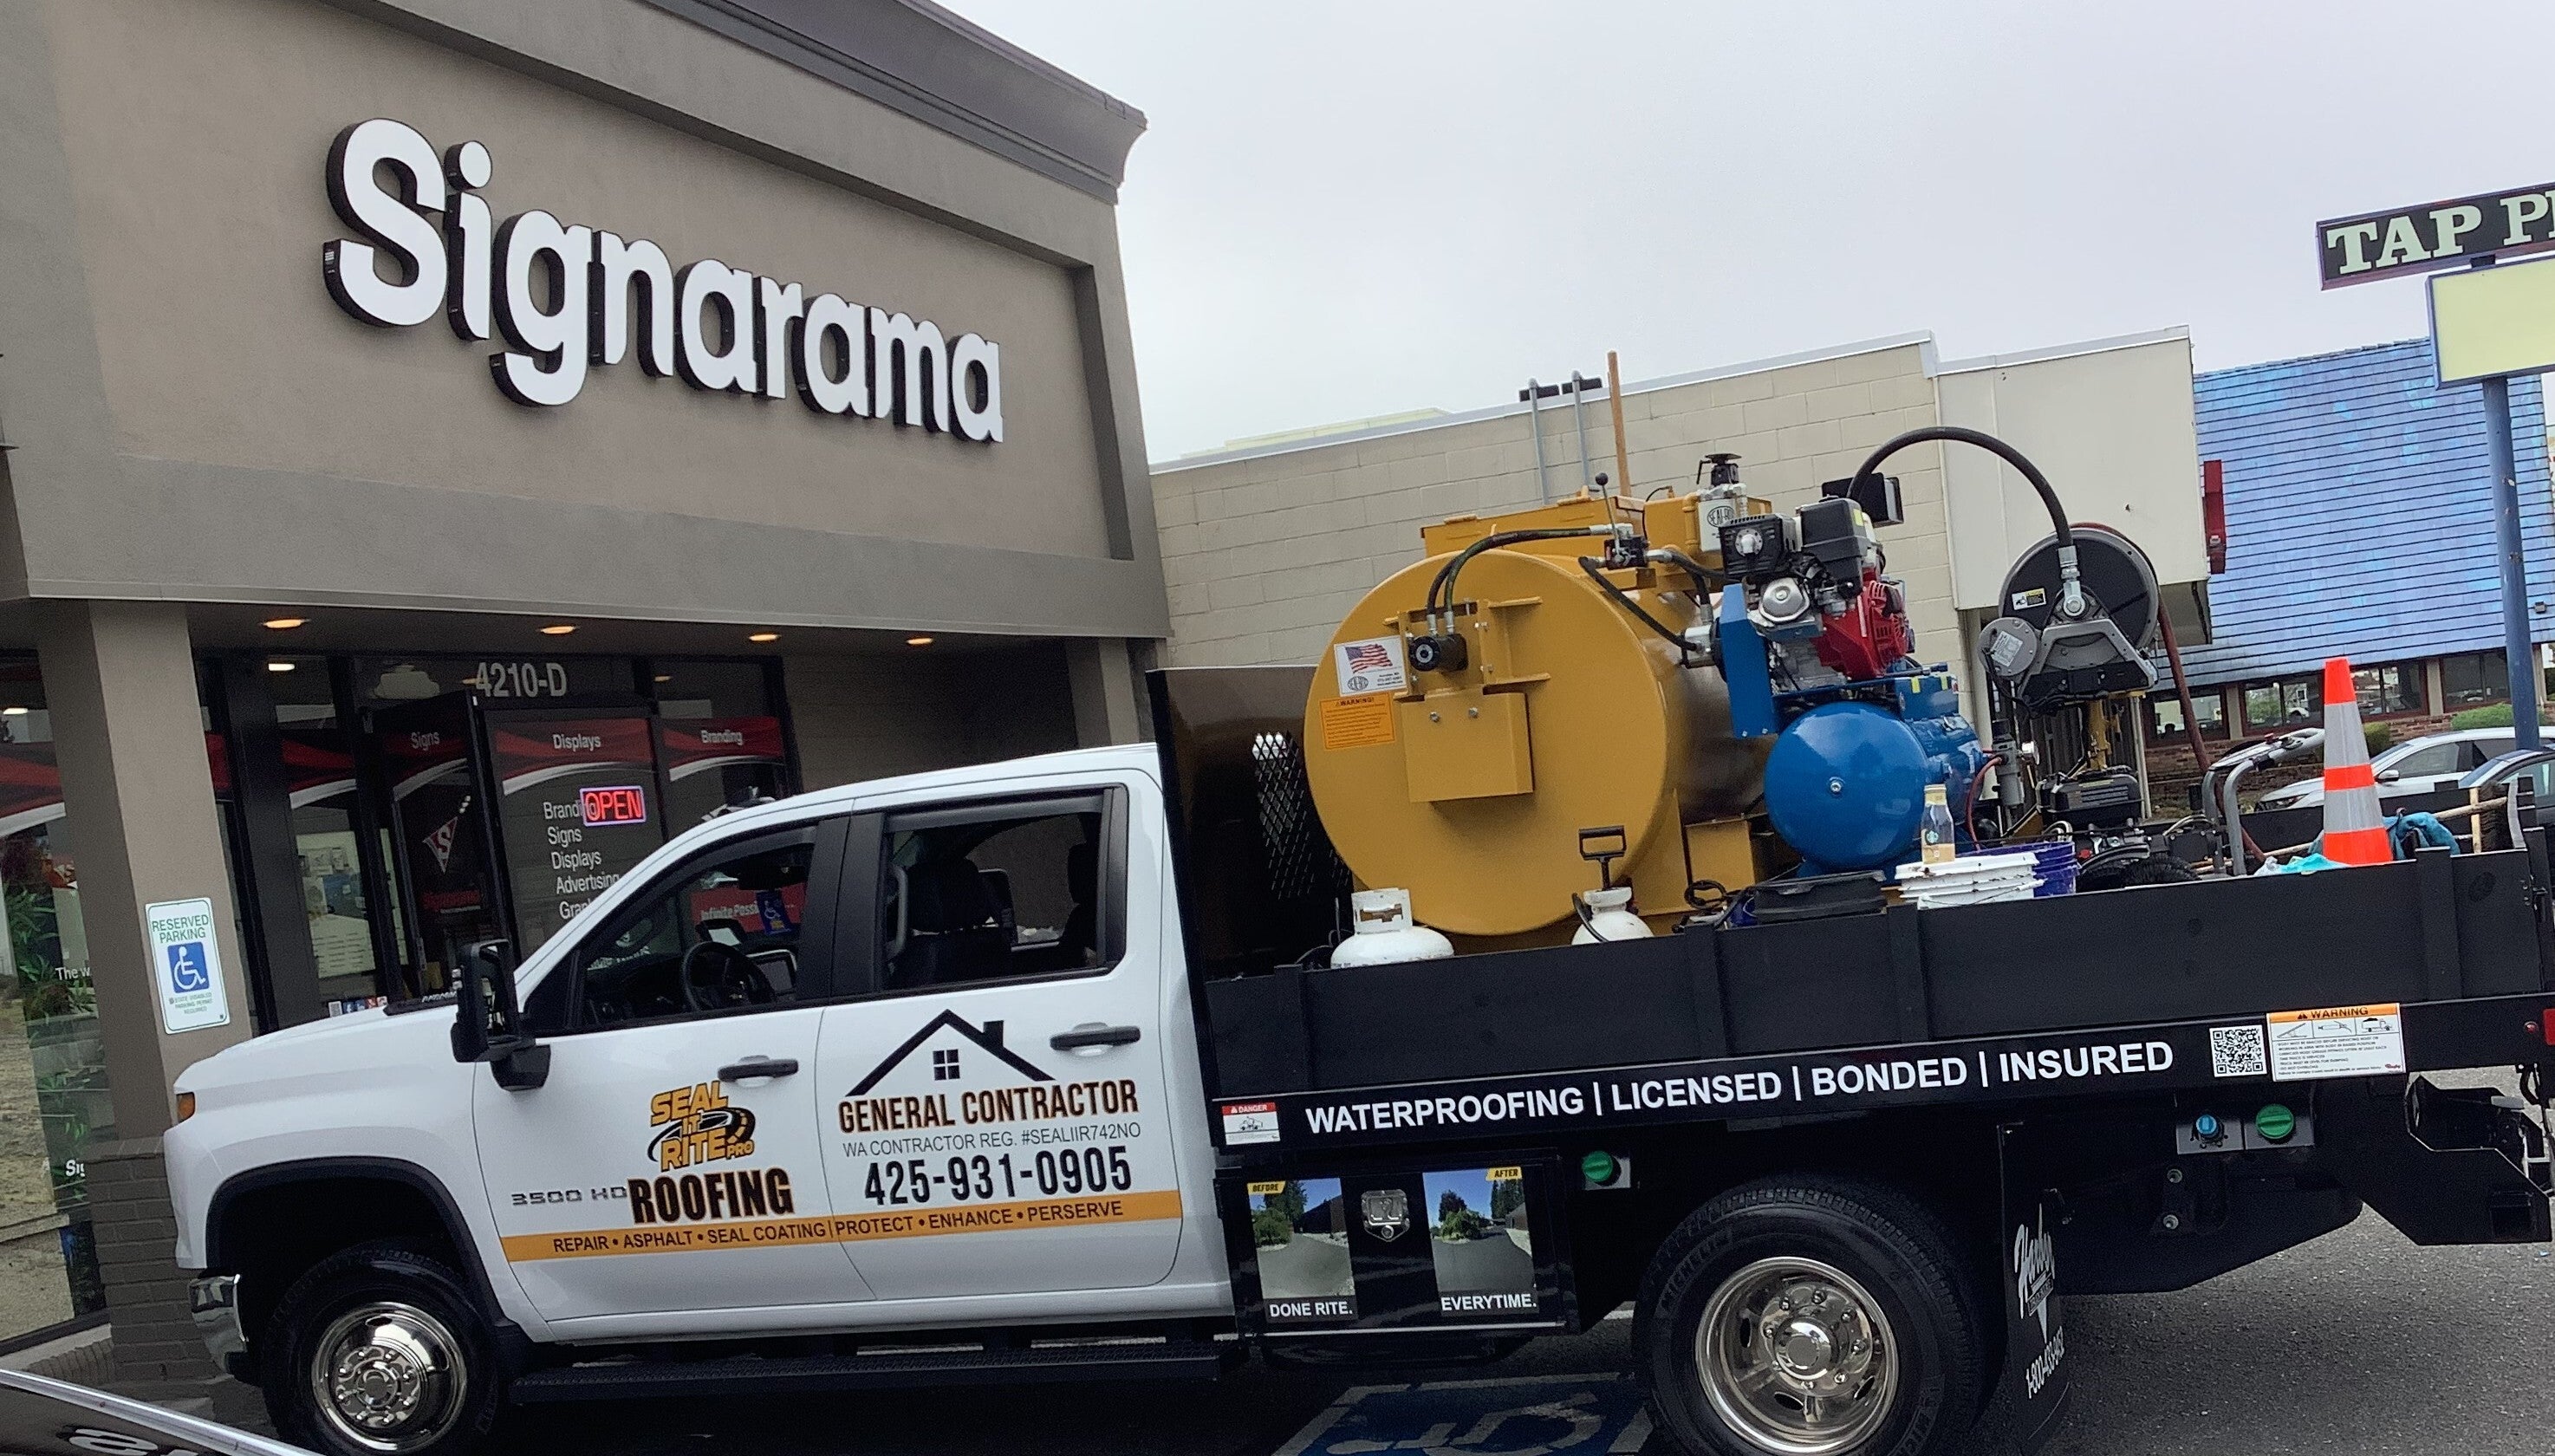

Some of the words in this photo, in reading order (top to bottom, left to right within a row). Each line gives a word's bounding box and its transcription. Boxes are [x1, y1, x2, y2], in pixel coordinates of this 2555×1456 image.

[2326, 205, 2482, 275] TAP
[324, 118, 1003, 443] Signarama
[476, 662, 568, 697] 4210-D
[411, 731, 439, 749] Signs
[552, 733, 601, 751] Displays
[701, 730, 744, 746] Branding
[543, 799, 584, 819] Brand
[584, 790, 642, 822] OPEN
[547, 826, 582, 848] Signs
[551, 849, 601, 872] Displays
[152, 914, 209, 932] RESERVED
[159, 927, 206, 943] PARKING
[55, 966, 78, 981] The
[2311, 1006, 2369, 1019] WARNING
[1305, 1087, 1584, 1134] WATERPROOFING
[1611, 1071, 1782, 1111] LICENSED
[1811, 1057, 1967, 1096] BONDED
[1999, 1042, 2174, 1082] INSURED
[650, 1081, 728, 1127] SEAL
[838, 1093, 955, 1134] GENERAL
[962, 1079, 1139, 1125] CONTRACTOR
[1238, 1103, 1268, 1114] DANGER
[681, 1113, 701, 1134] IT
[660, 1127, 727, 1173] RITE
[726, 1140, 755, 1160] PRO
[842, 1141, 868, 1158] WA
[870, 1134, 976, 1155] CONTRACTOR
[980, 1131, 1017, 1148] REG.
[1021, 1122, 1141, 1146] #SEALIIR742NO
[865, 1145, 1132, 1206] 425-931-0905
[1494, 1167, 1519, 1179] AFTER
[511, 1189, 582, 1206] 3500
[591, 1186, 627, 1201] HD
[627, 1167, 796, 1225] ROOFING
[1251, 1183, 1278, 1193] BEFORE
[554, 1235, 609, 1252] REPAIR
[623, 1231, 692, 1249] ASPHALT
[708, 1227, 750, 1244] SEAL
[754, 1222, 826, 1240] COATING
[835, 1216, 913, 1235] PROTECT
[929, 1209, 1012, 1229] ENHANCE
[1028, 1201, 1123, 1222] PERSERVE
[1270, 1303, 1311, 1318] DONE
[1316, 1302, 1353, 1316] RITE.
[1441, 1294, 1538, 1312] EVERYTIME.
